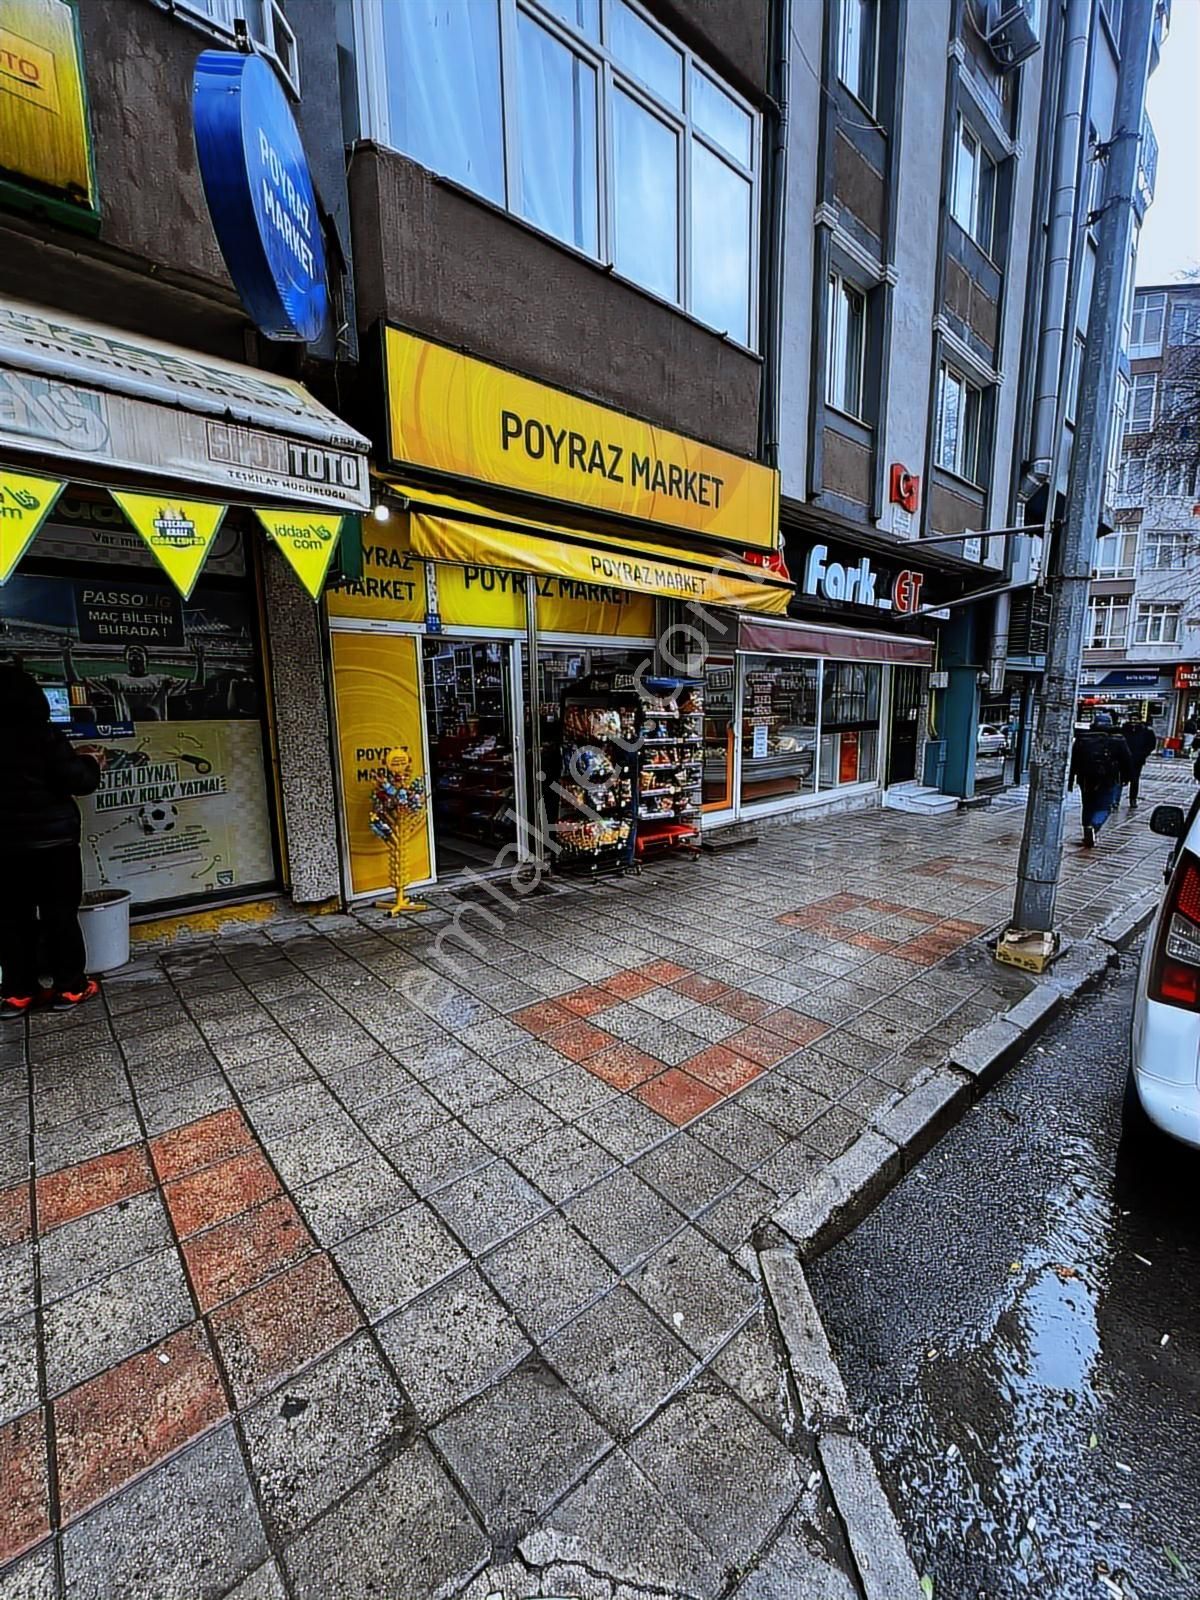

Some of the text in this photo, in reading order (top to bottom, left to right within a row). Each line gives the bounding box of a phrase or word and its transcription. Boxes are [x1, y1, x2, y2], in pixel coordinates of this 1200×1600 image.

[0, 47, 39, 81] TO
[258, 127, 311, 239] POYRAZ
[262, 178, 314, 280] MARKET
[289, 444, 359, 488] TOTO
[501, 409, 724, 509] POYRAZ MARKET
[273, 523, 312, 539] iddaa
[293, 539, 323, 550] com
[361, 545, 415, 571] YRAZ
[591, 555, 707, 595] POYRAZ MARKET
[88, 610, 119, 624] MAÇ
[98, 624, 160, 637] BURADA
[99, 769, 133, 791] STEM
[96, 789, 136, 810] KOLAY
[139, 784, 177, 803] KOLAY
